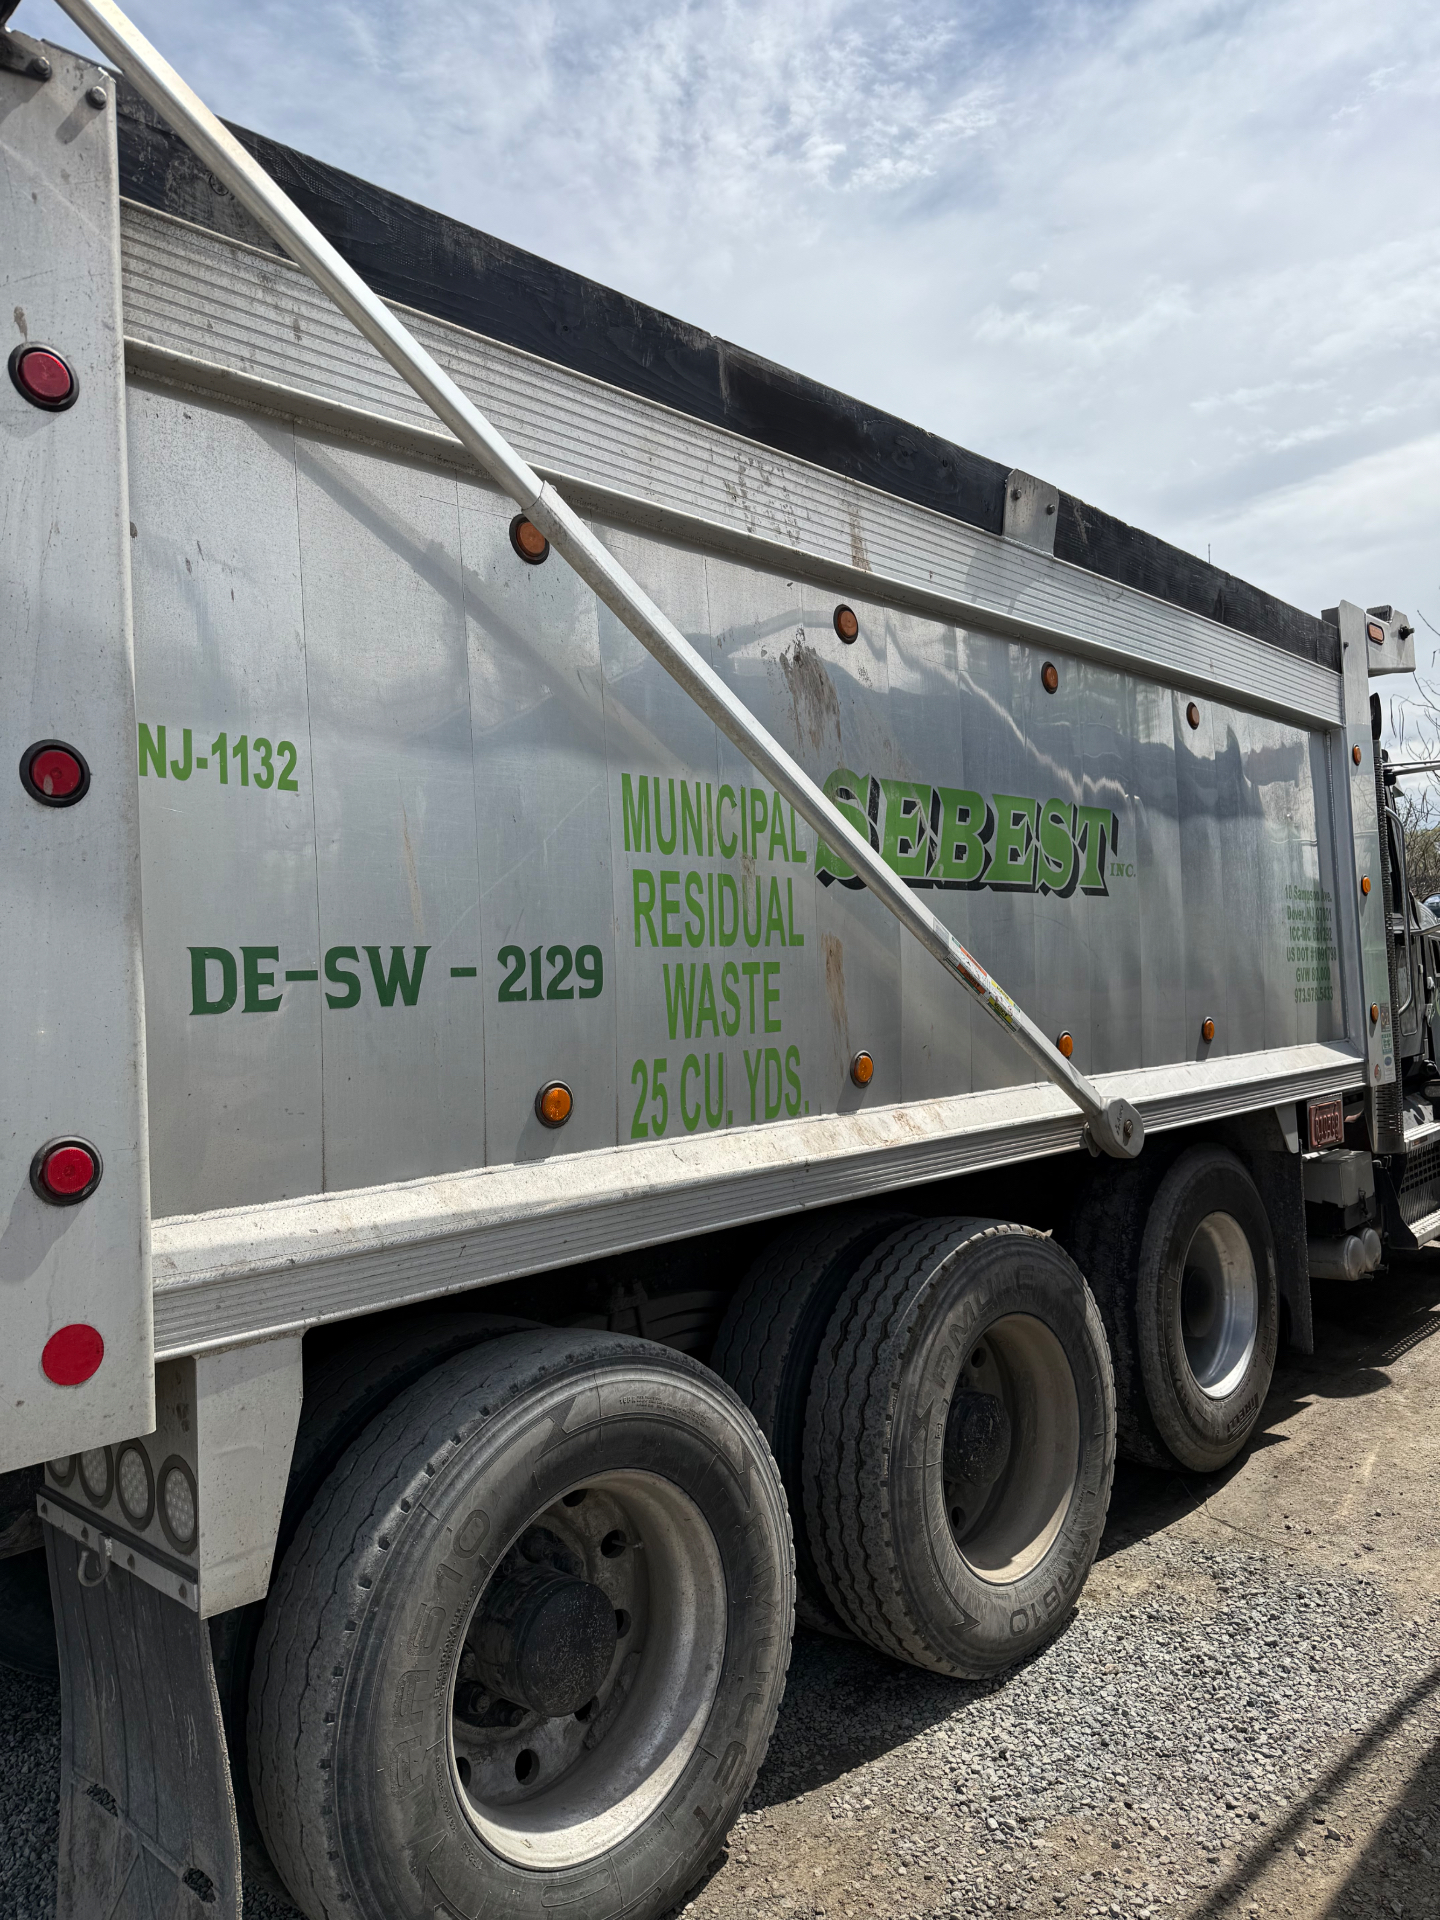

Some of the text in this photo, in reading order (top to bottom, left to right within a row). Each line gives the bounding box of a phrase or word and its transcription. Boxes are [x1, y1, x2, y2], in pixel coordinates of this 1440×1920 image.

[138, 722, 298, 791] NJ-1132
[621, 773, 807, 864] MUNICIPAL
[814, 768, 1118, 897] SEBEST
[632, 868, 805, 948] RESIDUAL
[1109, 862, 1136, 878] INC.
[497, 944, 604, 1002] 2129
[1286, 947, 1295, 962] US
[1296, 947, 1309, 962] DOT
[662, 961, 782, 1040] WASTE
[630, 1045, 810, 1139] 25 CU. YDS.
